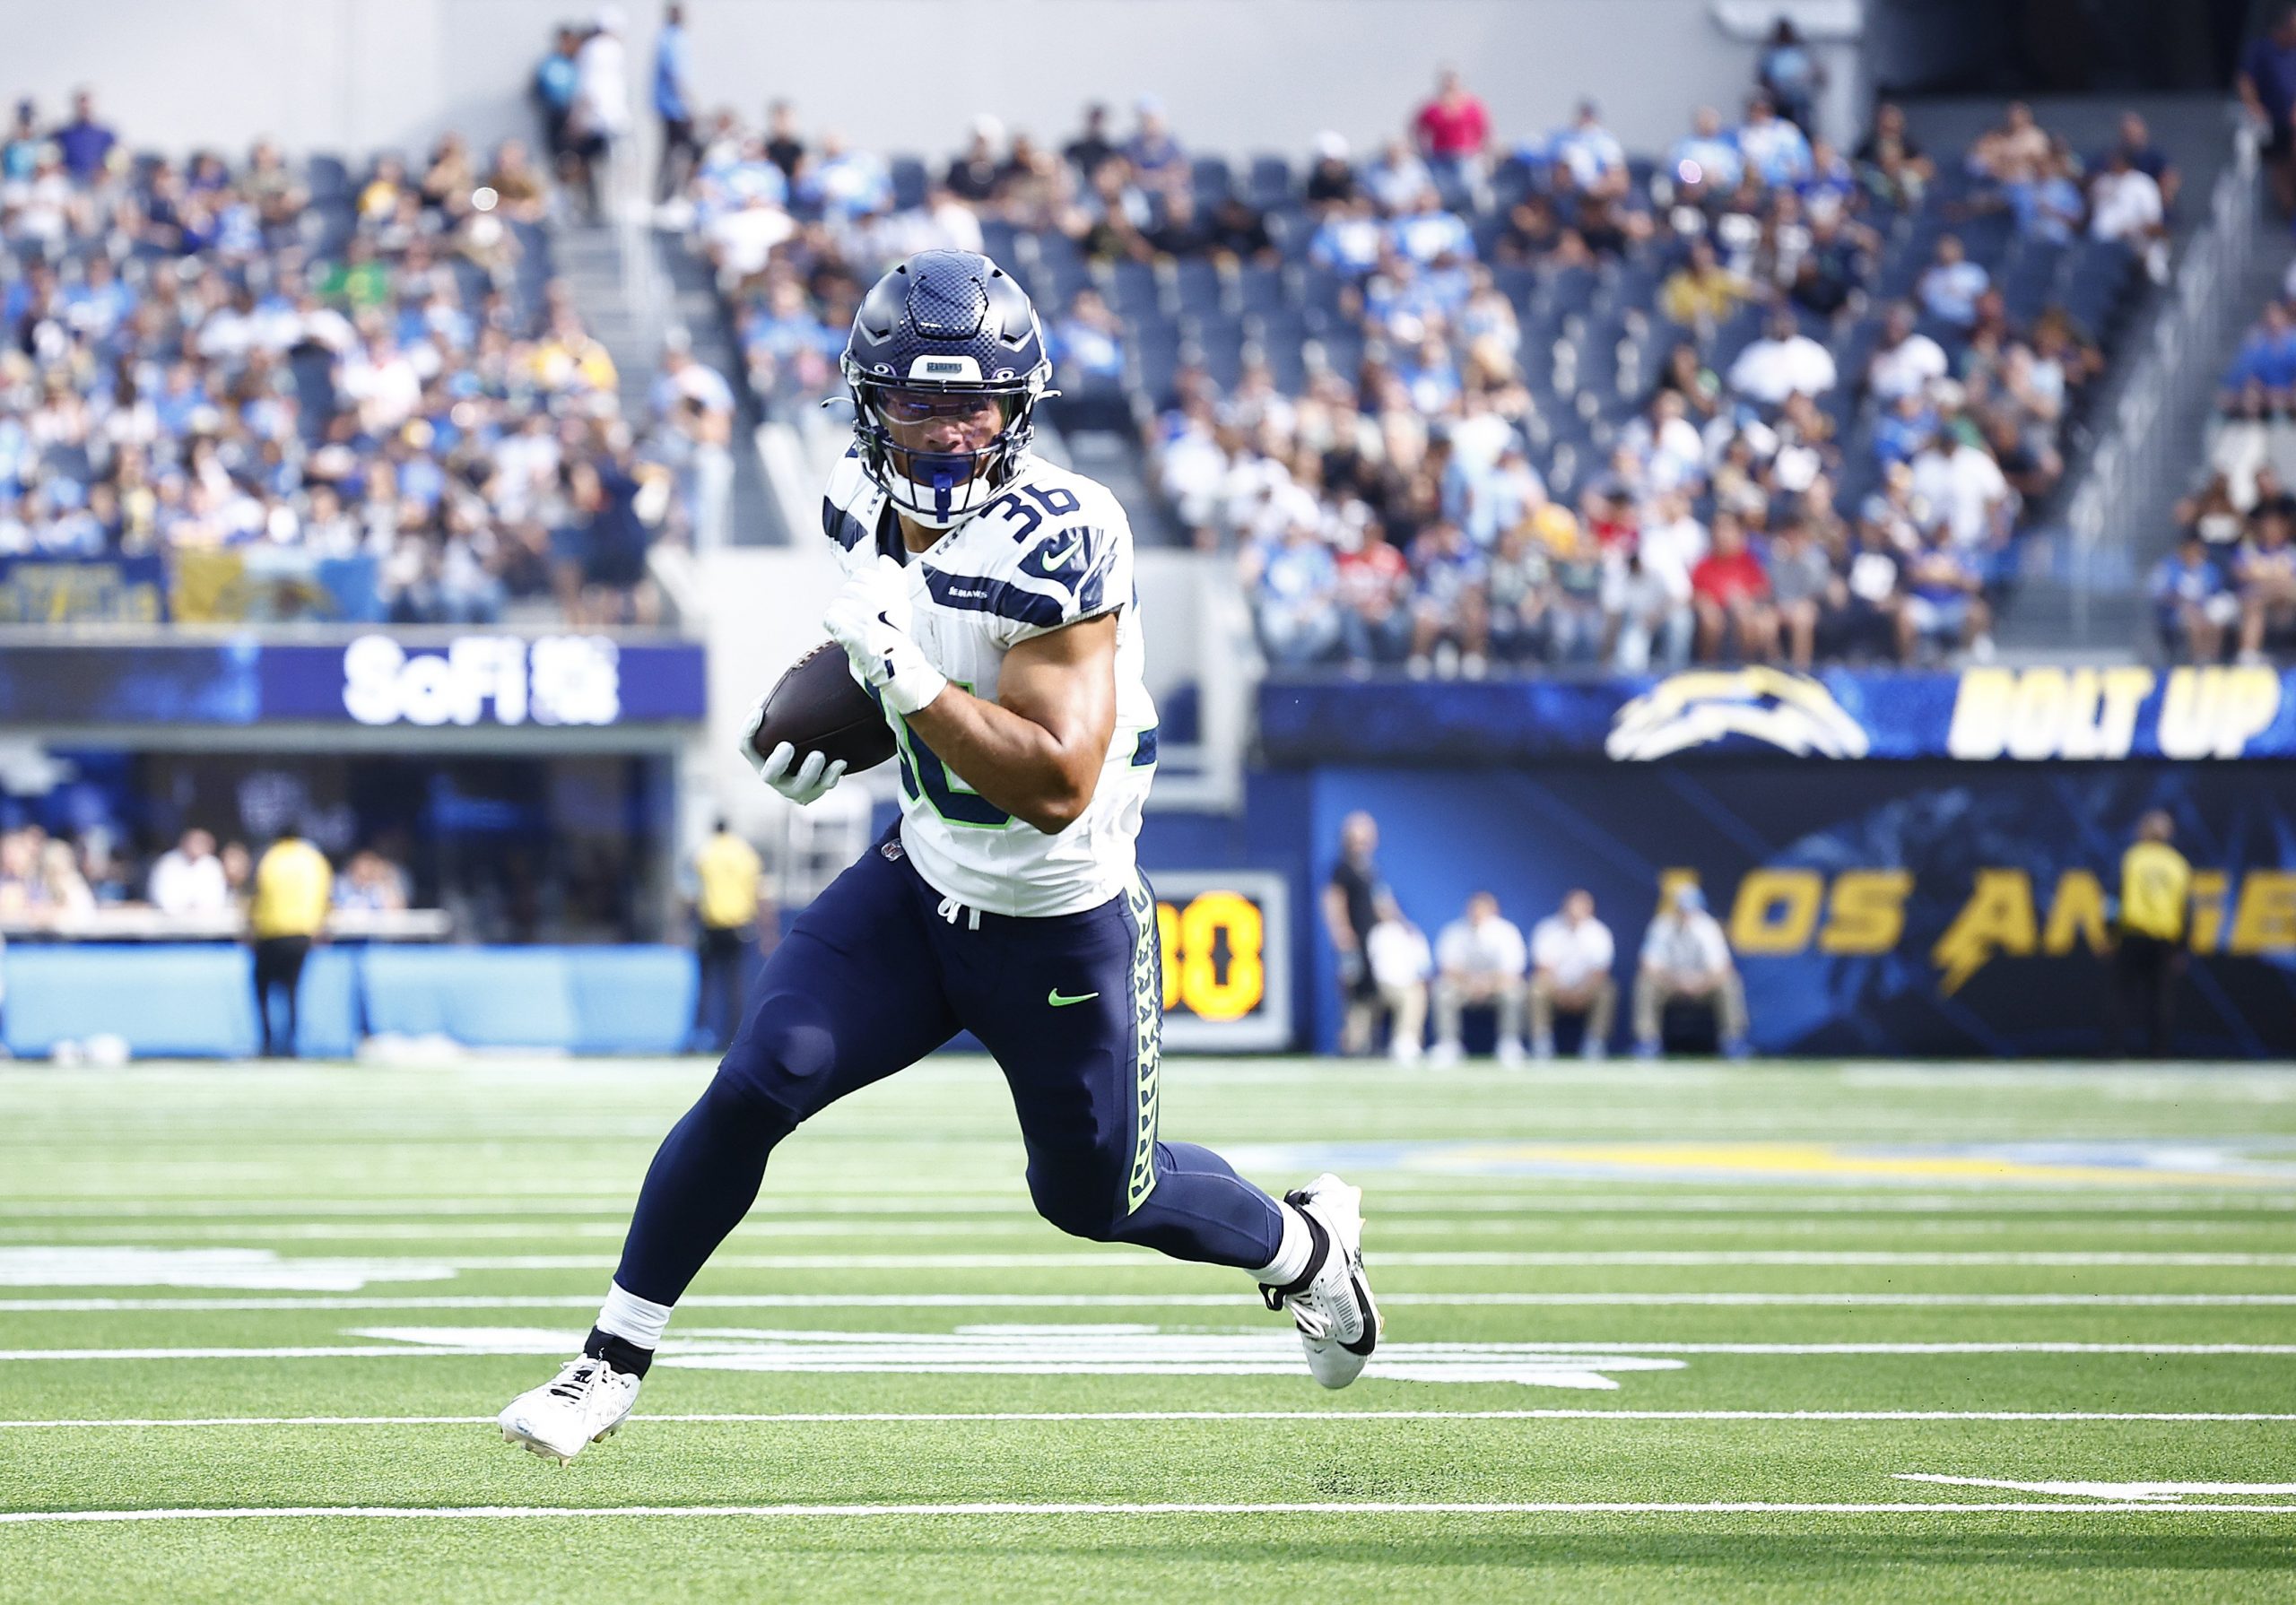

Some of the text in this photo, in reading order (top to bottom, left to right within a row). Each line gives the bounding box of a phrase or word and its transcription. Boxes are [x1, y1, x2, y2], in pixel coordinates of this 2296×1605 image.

[978, 483, 1080, 544] 36
[948, 586, 988, 600] SEHAWS
[343, 635, 527, 725] SoFi
[1947, 666, 2281, 760] BOLT UP
